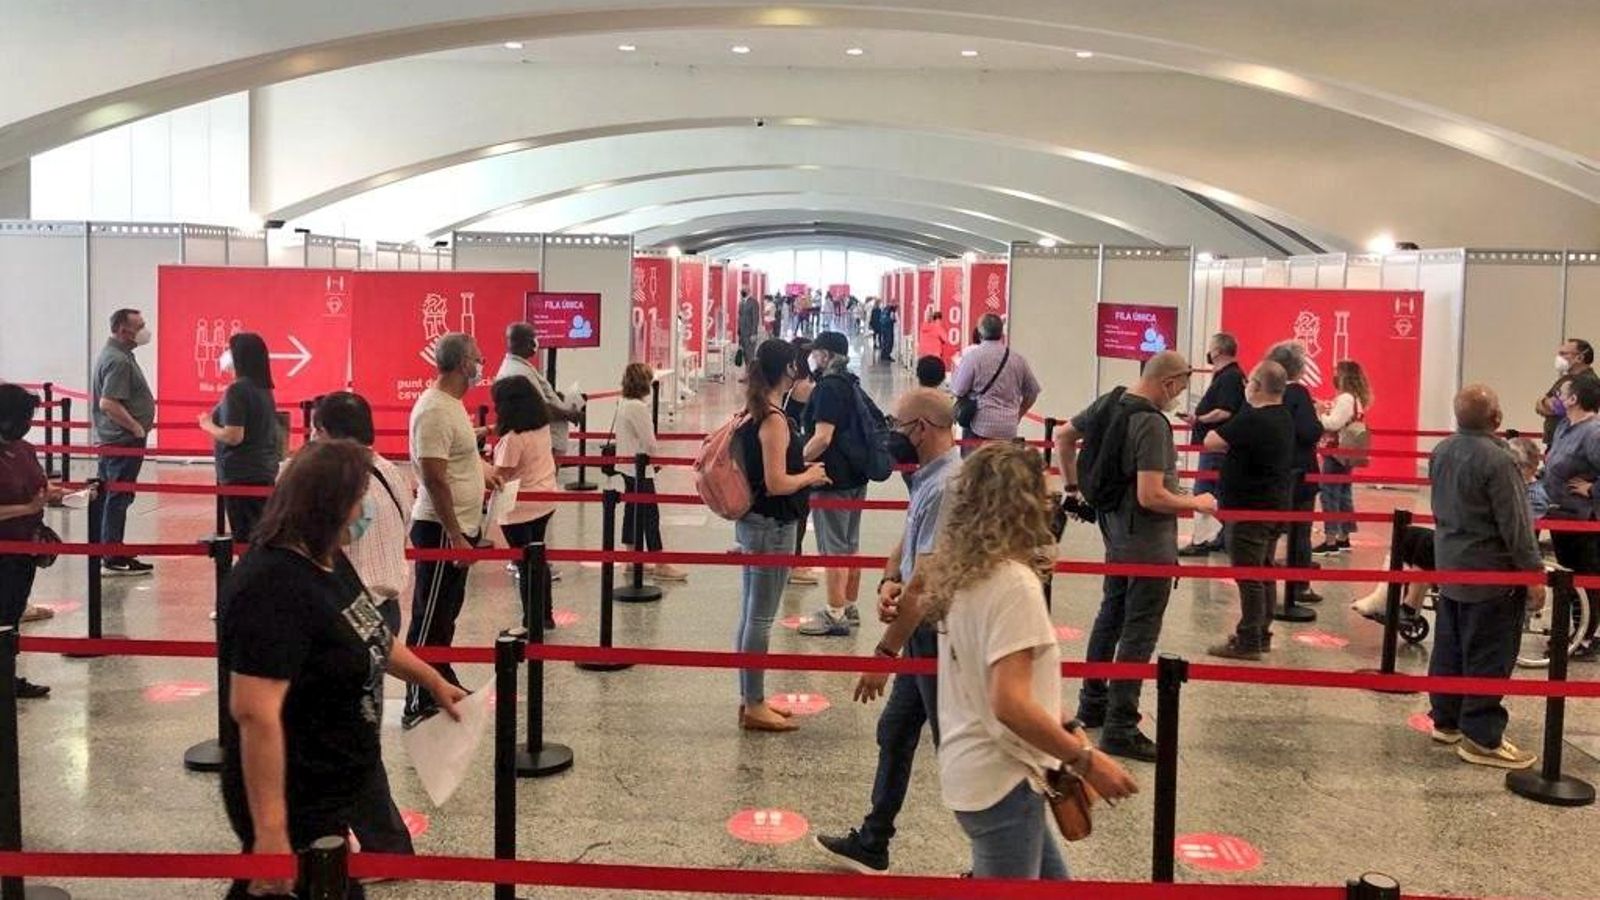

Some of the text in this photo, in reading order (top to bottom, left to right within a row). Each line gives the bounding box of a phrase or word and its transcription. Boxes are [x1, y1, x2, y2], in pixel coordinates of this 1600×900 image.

[544, 300, 560, 309] FILA
[632, 306, 657, 329] 01
[1114, 311, 1131, 321] FILA
[397, 378, 422, 389] punt
